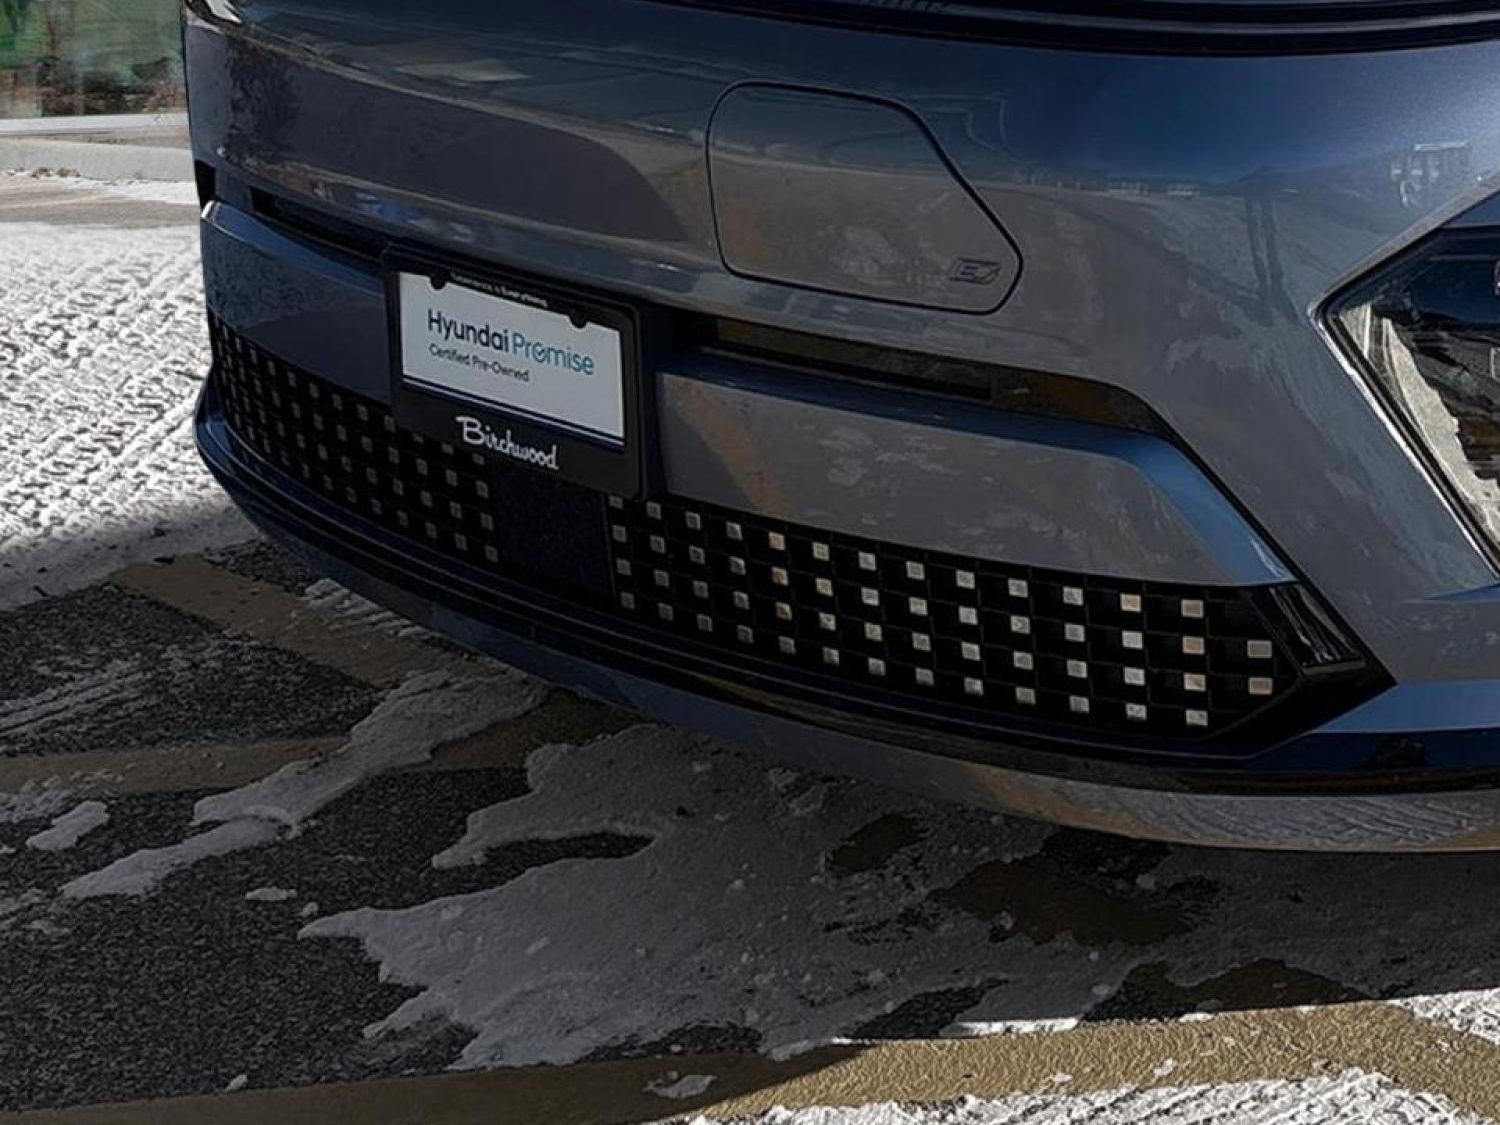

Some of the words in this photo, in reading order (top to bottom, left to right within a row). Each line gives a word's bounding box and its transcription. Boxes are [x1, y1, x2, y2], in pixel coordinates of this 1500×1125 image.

[427, 308, 509, 353] Hyundai
[512, 332, 595, 375] Promise
[428, 342, 471, 366] Certified
[472, 354, 530, 383] Pre-Owned
[455, 415, 559, 471] Birchwood
